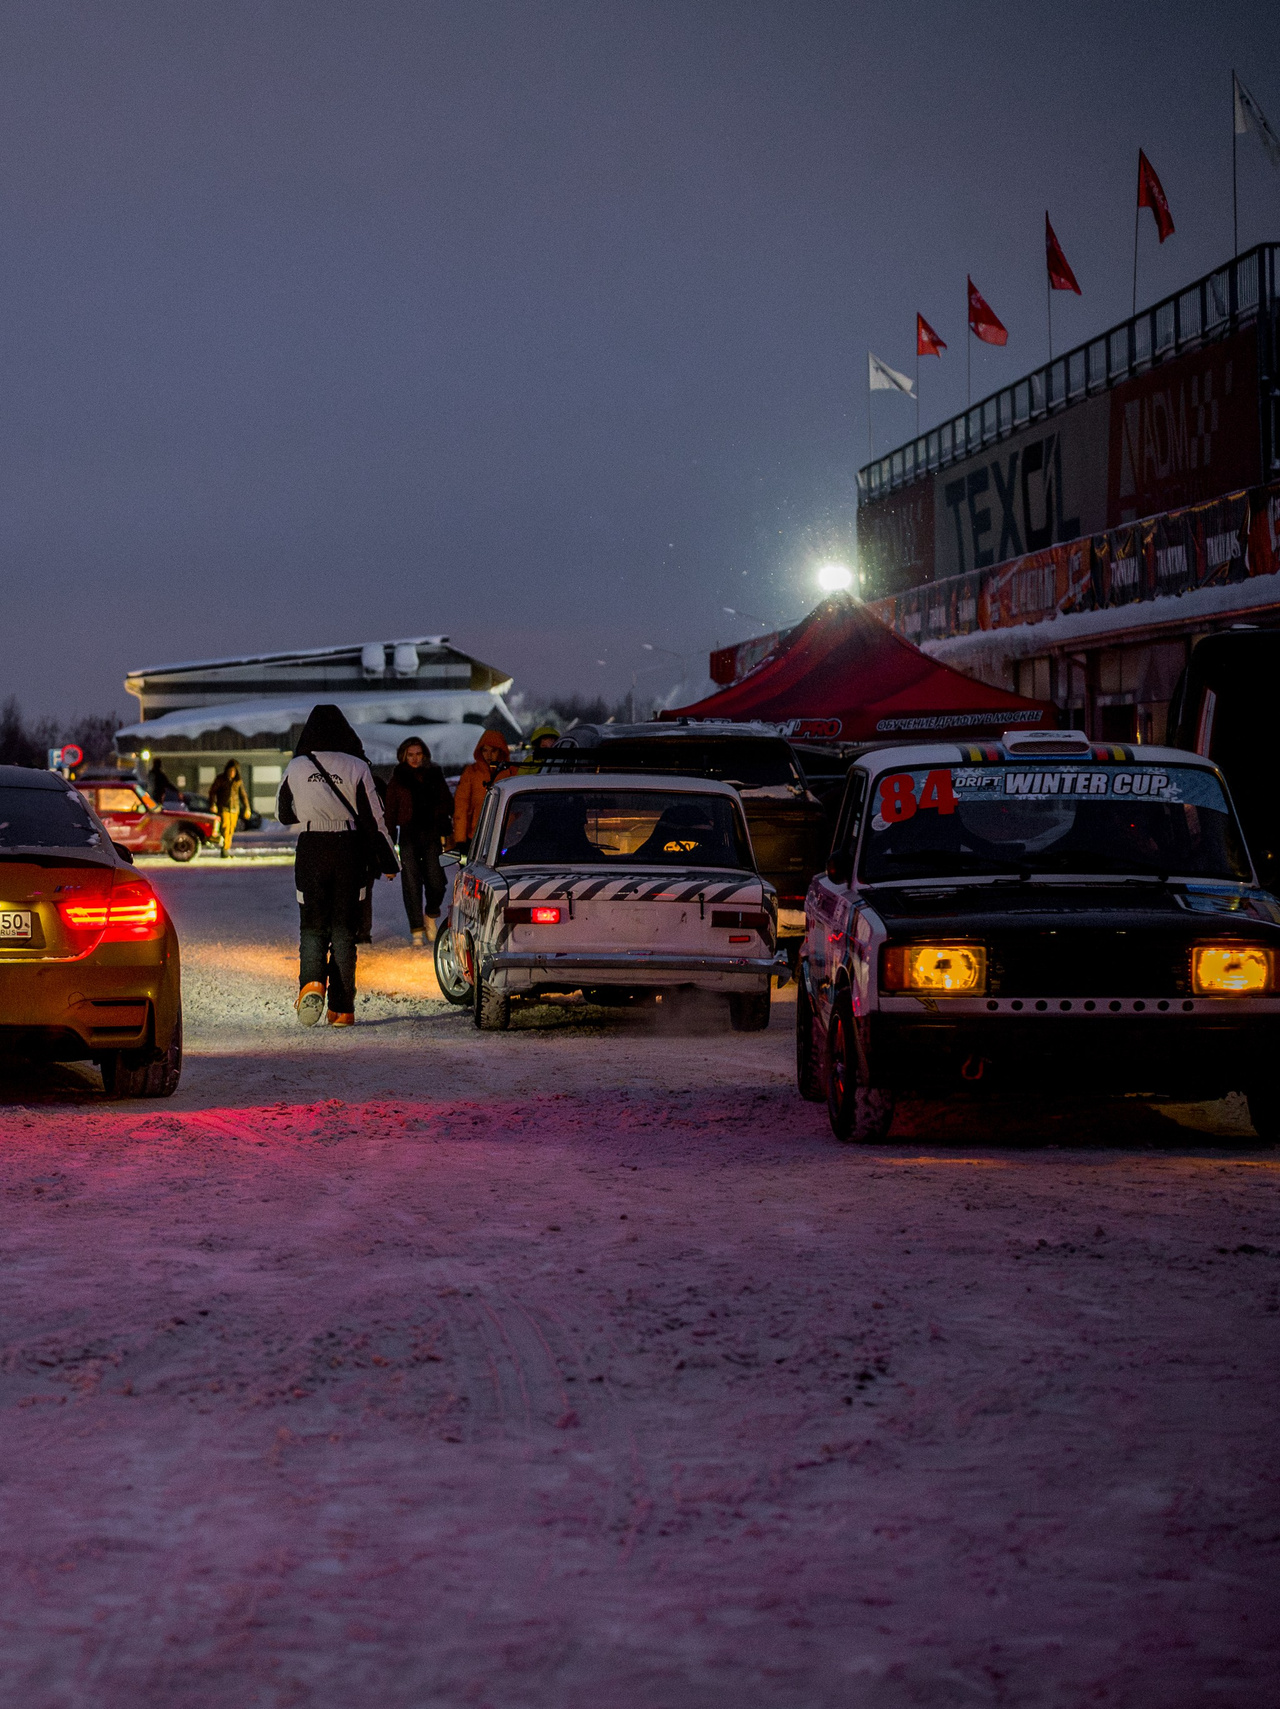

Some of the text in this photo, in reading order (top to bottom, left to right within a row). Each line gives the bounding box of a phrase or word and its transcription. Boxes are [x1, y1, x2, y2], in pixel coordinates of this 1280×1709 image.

[876, 717, 936, 731] ОБУЧЕНИЕ
[994, 710, 1043, 722] МОСКВЕ
[880, 769, 1169, 823] 84 DRIFT WINTER CUP
[1, 914, 23, 930] 50
